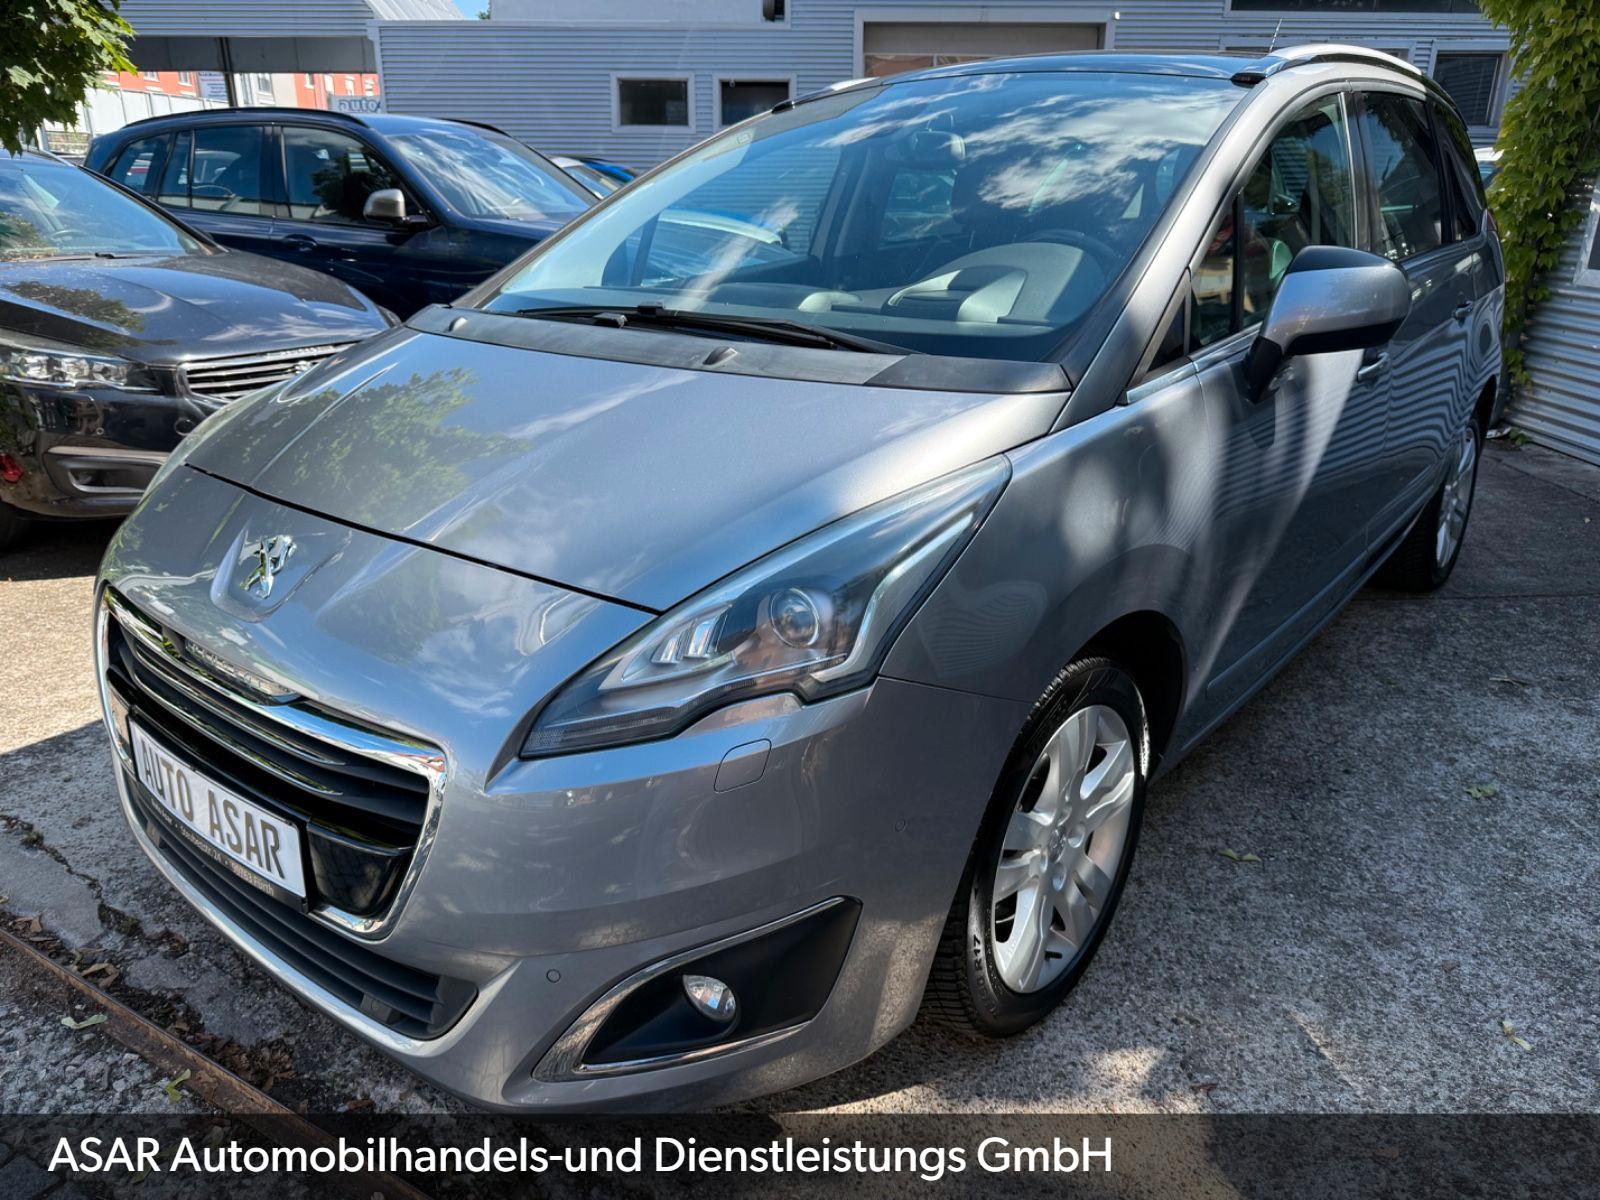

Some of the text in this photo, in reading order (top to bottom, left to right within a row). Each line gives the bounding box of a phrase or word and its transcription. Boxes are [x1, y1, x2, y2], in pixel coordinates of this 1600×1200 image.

[338, 98, 381, 113] auto
[141, 739, 285, 880] AUTO ASAR
